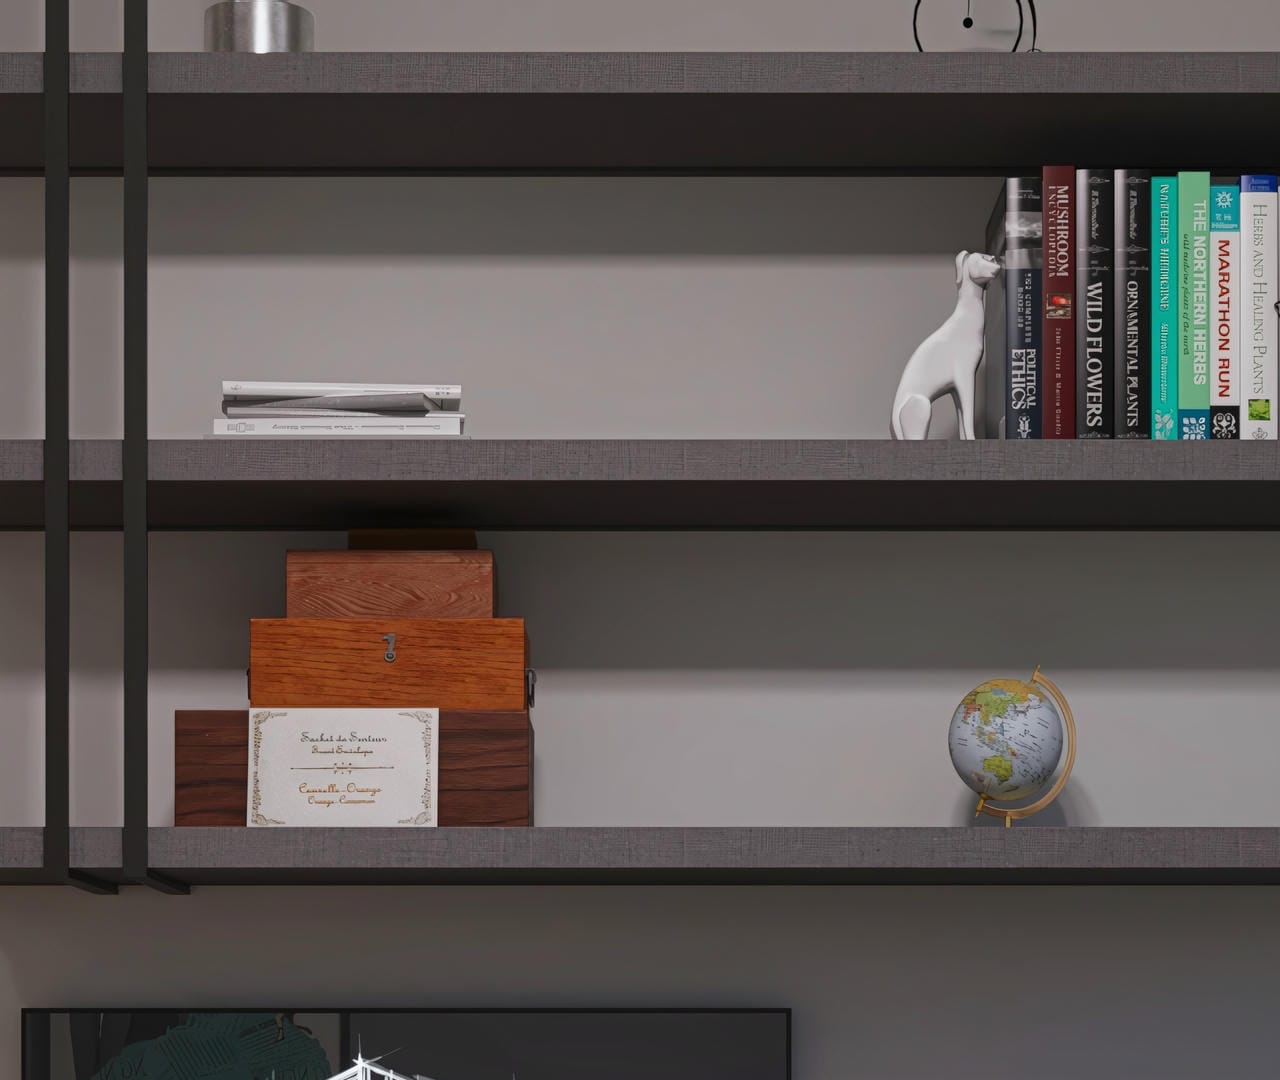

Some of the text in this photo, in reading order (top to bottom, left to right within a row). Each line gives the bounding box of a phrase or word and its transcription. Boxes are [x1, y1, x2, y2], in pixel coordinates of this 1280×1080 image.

[1056, 185, 1068, 277] MUSHROOM
[1254, 204, 1267, 246] HERBS
[1193, 200, 1206, 385] THE NORTHERN HERBS
[1254, 250, 1264, 278] AND
[1218, 240, 1230, 351] MARATHON
[1253, 282, 1267, 341] HEALING
[1011, 348, 1025, 409] ETHICS
[1026, 348, 1036, 408] POLITICAL
[1087, 282, 1102, 427] WILD FLOWERS
[1127, 281, 1138, 427] ORNAMENTAL PLANTS
[1218, 358, 1230, 397] RUN
[1254, 345, 1267, 394] PLANTS
